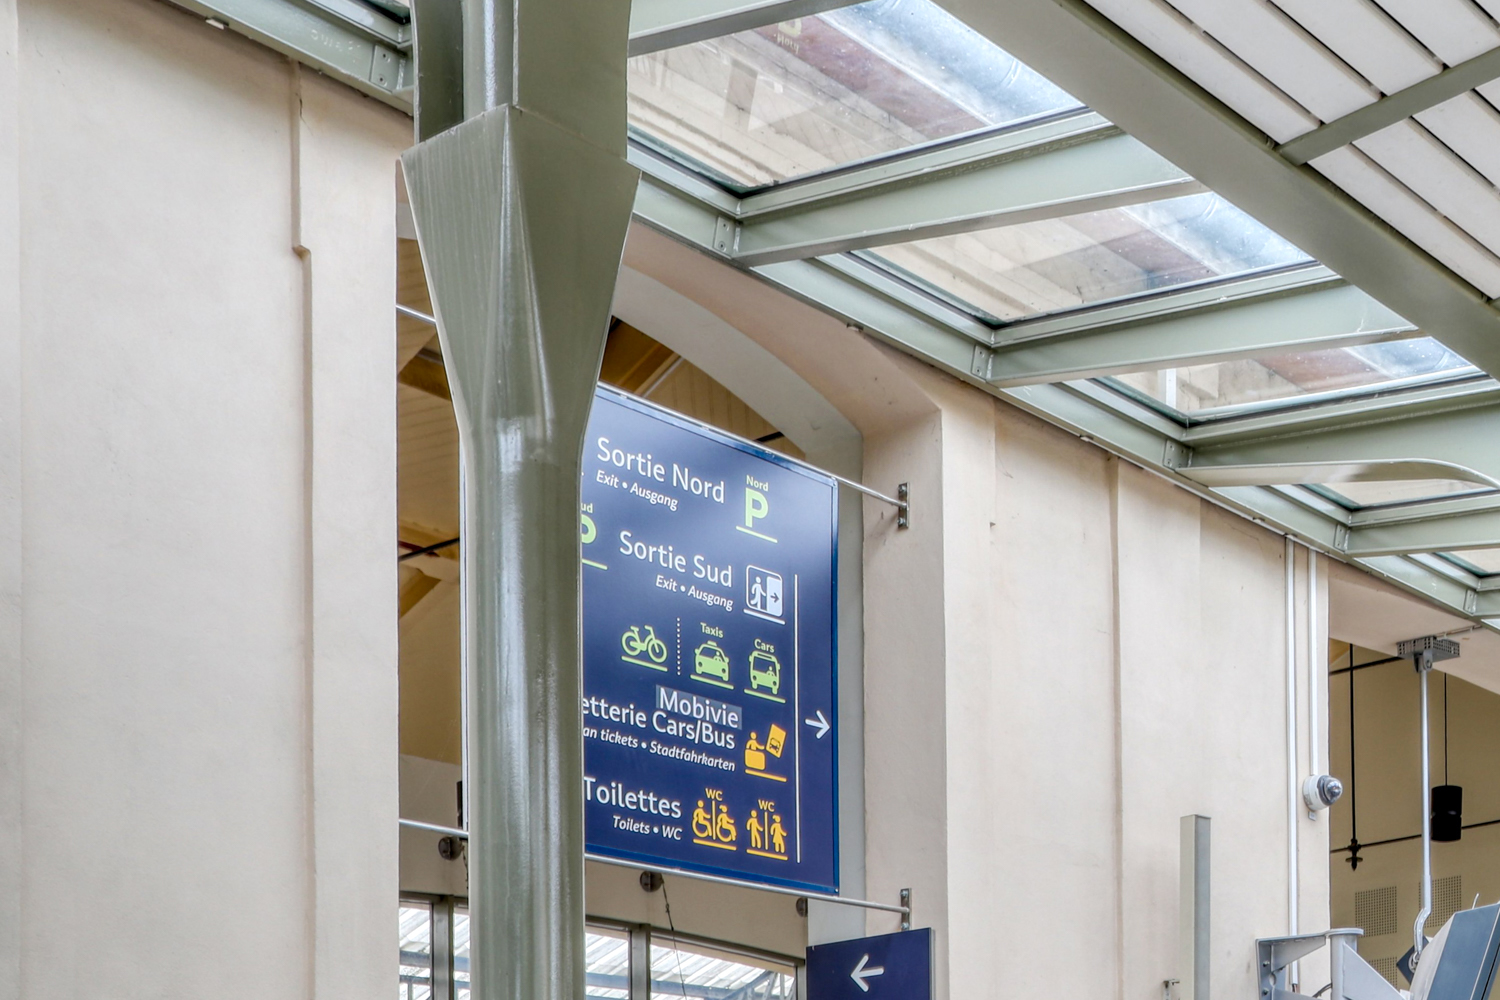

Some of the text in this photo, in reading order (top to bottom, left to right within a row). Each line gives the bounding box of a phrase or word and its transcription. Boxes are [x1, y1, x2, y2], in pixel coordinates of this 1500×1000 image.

[597, 437, 724, 503] Sortie Nord
[746, 475, 769, 492] Nord
[596, 470, 678, 511] Exit Ausgang
[745, 488, 769, 528] P
[619, 531, 732, 588] Sortie Sud
[656, 575, 733, 611] Exit Ausgang
[700, 622, 723, 638] Taxis
[754, 639, 774, 653] Cars
[659, 687, 739, 728] Mobivie
[652, 711, 735, 749] Cars/Bus
[600, 729, 638, 748] tickets
[650, 741, 735, 771] Stadtfahrkarten
[583, 776, 682, 818] Toilettes
[705, 788, 723, 801] WC
[758, 799, 775, 812] WC
[612, 815, 682, 840] Toilets WC
